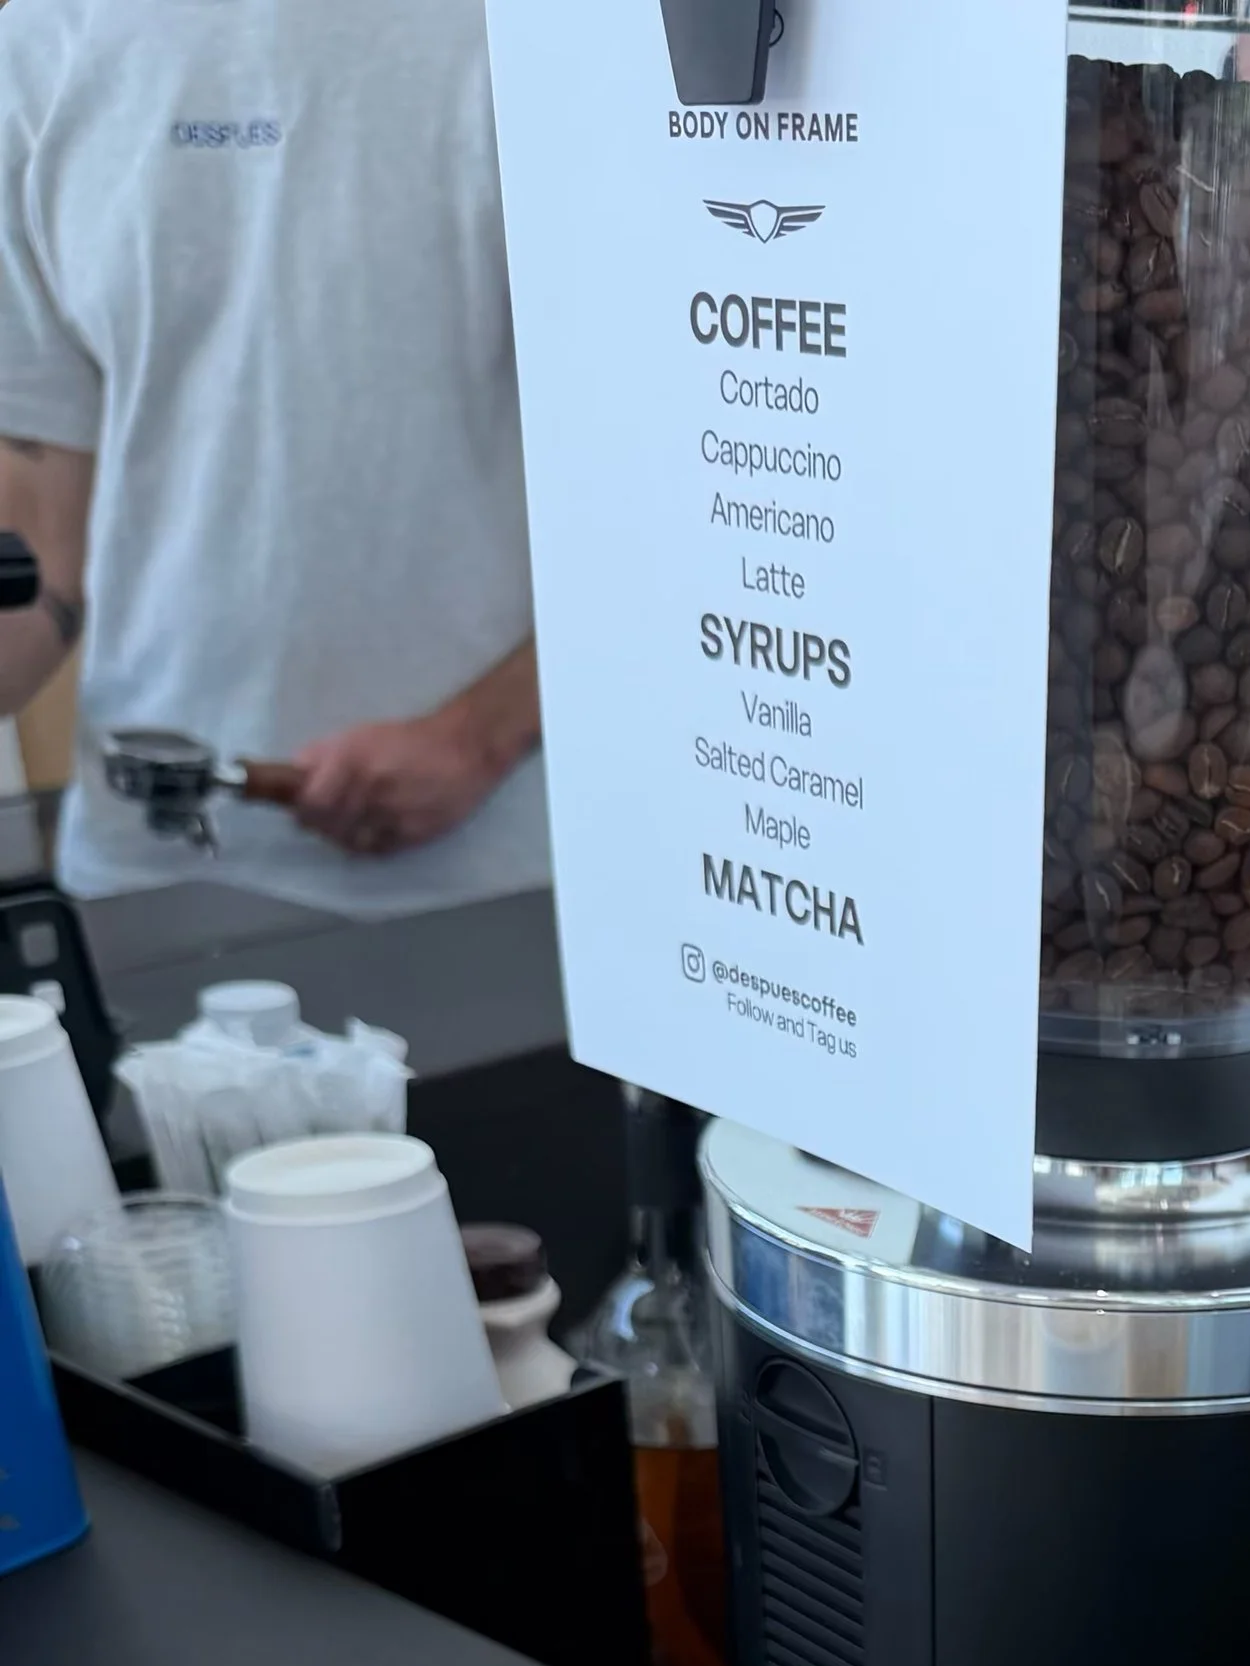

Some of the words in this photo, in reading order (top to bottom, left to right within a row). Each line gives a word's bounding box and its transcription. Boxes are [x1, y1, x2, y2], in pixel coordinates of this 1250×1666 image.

[668, 110, 727, 139] BODY
[735, 111, 770, 140] ON
[777, 112, 858, 142] FRAME
[690, 291, 847, 358] COFFEE
[720, 369, 820, 414] Cortado
[701, 429, 842, 481] Cappuccino
[710, 492, 835, 543] Americano
[741, 556, 806, 599] Latte
[700, 612, 852, 688] SYRUPS
[740, 690, 813, 737] Vanilla
[695, 737, 766, 783] Salted
[770, 756, 864, 809] Caramel
[745, 803, 811, 850] Maple
[702, 853, 865, 946] MATCHA
[712, 960, 857, 1027] @despuescoffee
[727, 992, 775, 1027] Follow
[777, 1013, 805, 1039] and
[806, 1020, 837, 1056] Tag
[839, 1037, 858, 1059] us
